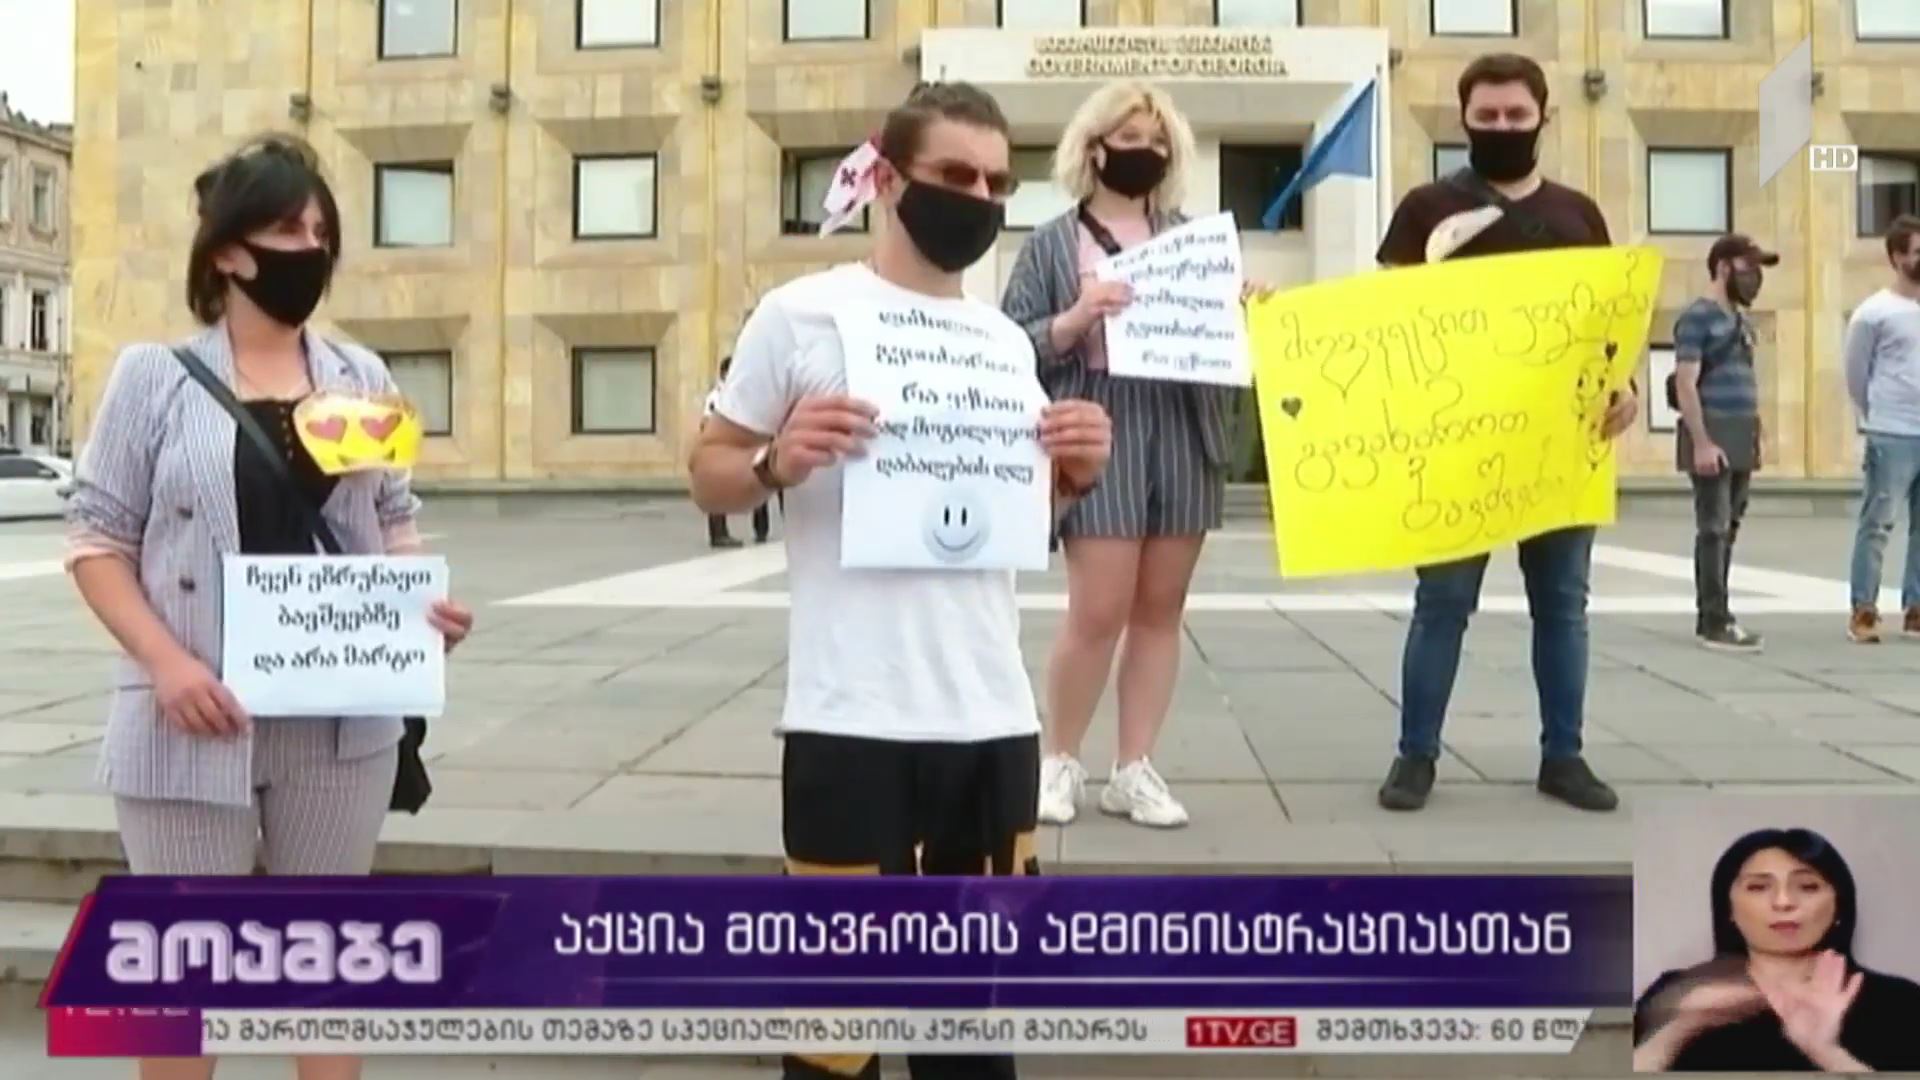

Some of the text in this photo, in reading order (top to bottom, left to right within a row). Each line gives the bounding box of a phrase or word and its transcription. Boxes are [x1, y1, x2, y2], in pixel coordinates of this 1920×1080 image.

[876, 453, 1034, 486] დაბადების დღე
[246, 564, 431, 593] ჩვენ ვზრუნავთ
[278, 602, 401, 632] ბავშვებზე
[253, 645, 425, 674] და არა მარტო
